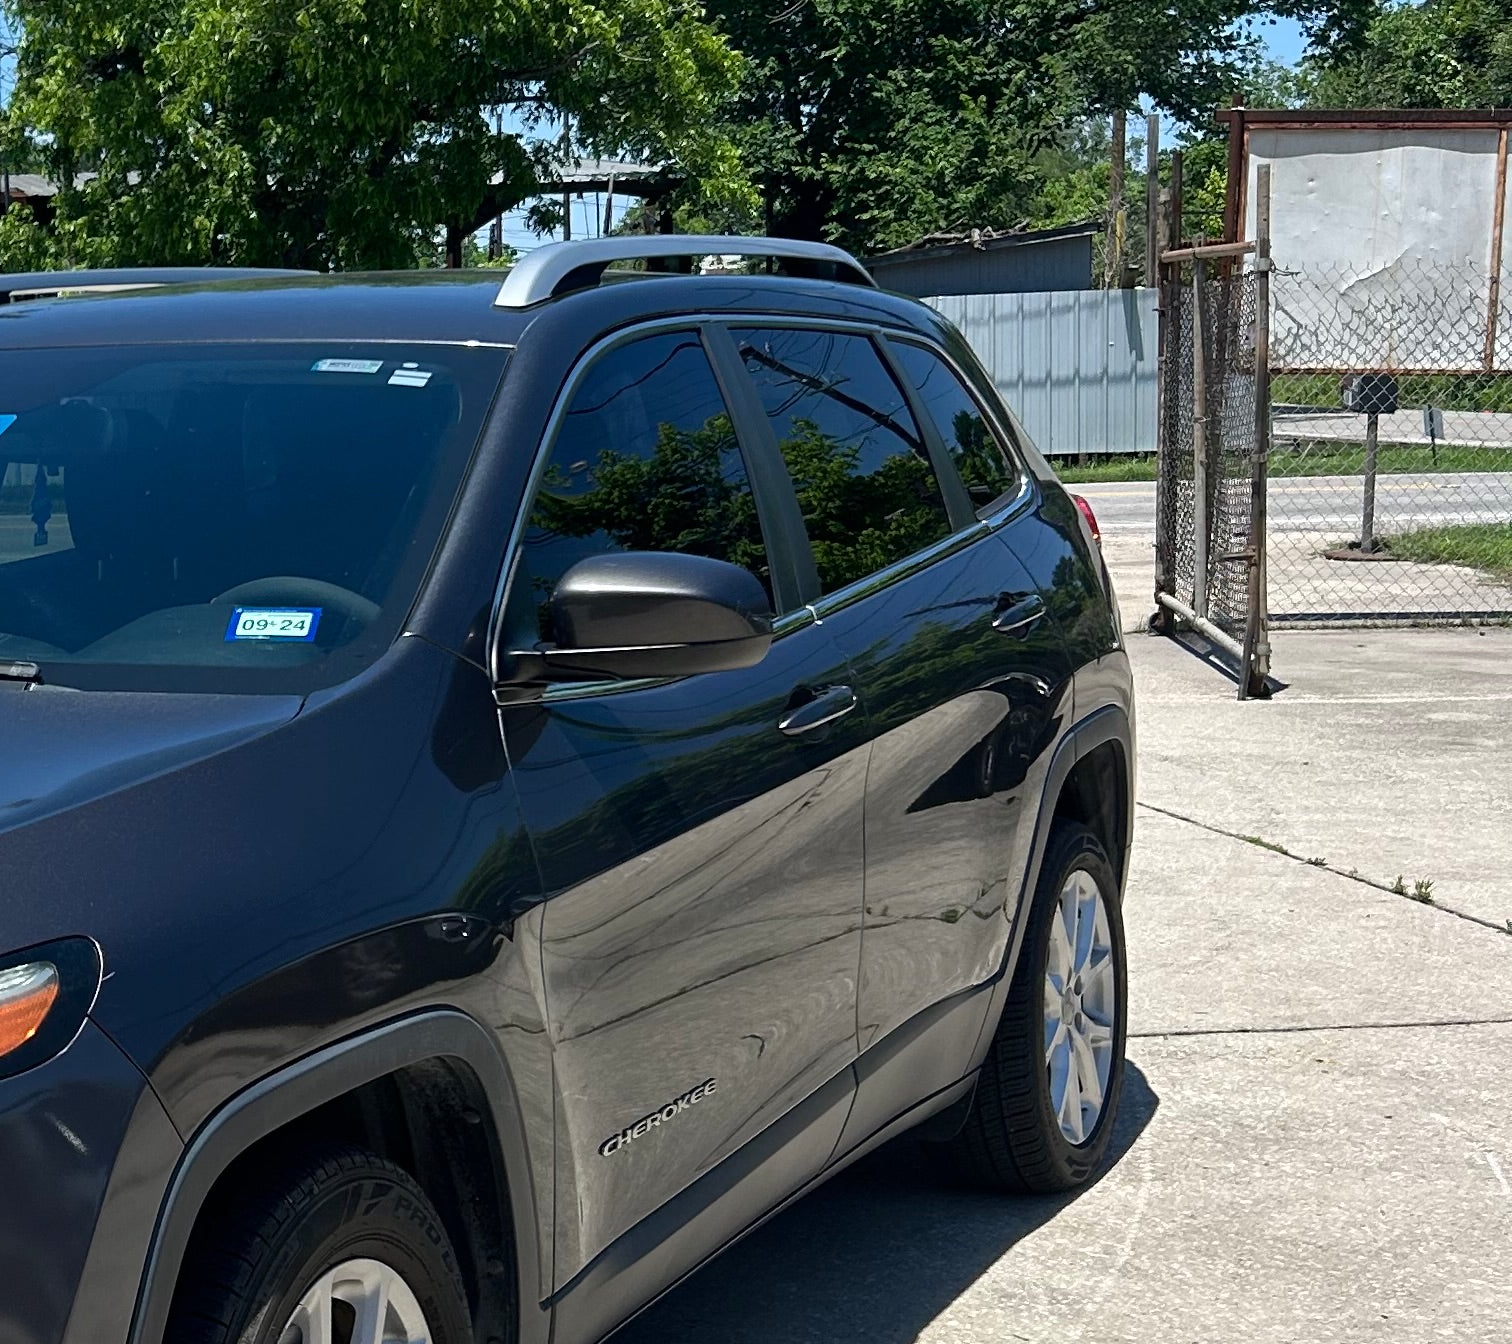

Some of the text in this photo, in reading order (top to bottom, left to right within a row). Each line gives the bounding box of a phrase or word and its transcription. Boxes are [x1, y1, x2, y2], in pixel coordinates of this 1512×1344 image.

[242, 619, 306, 631] 09 24
[599, 1078, 717, 1156] CHEROKEE
